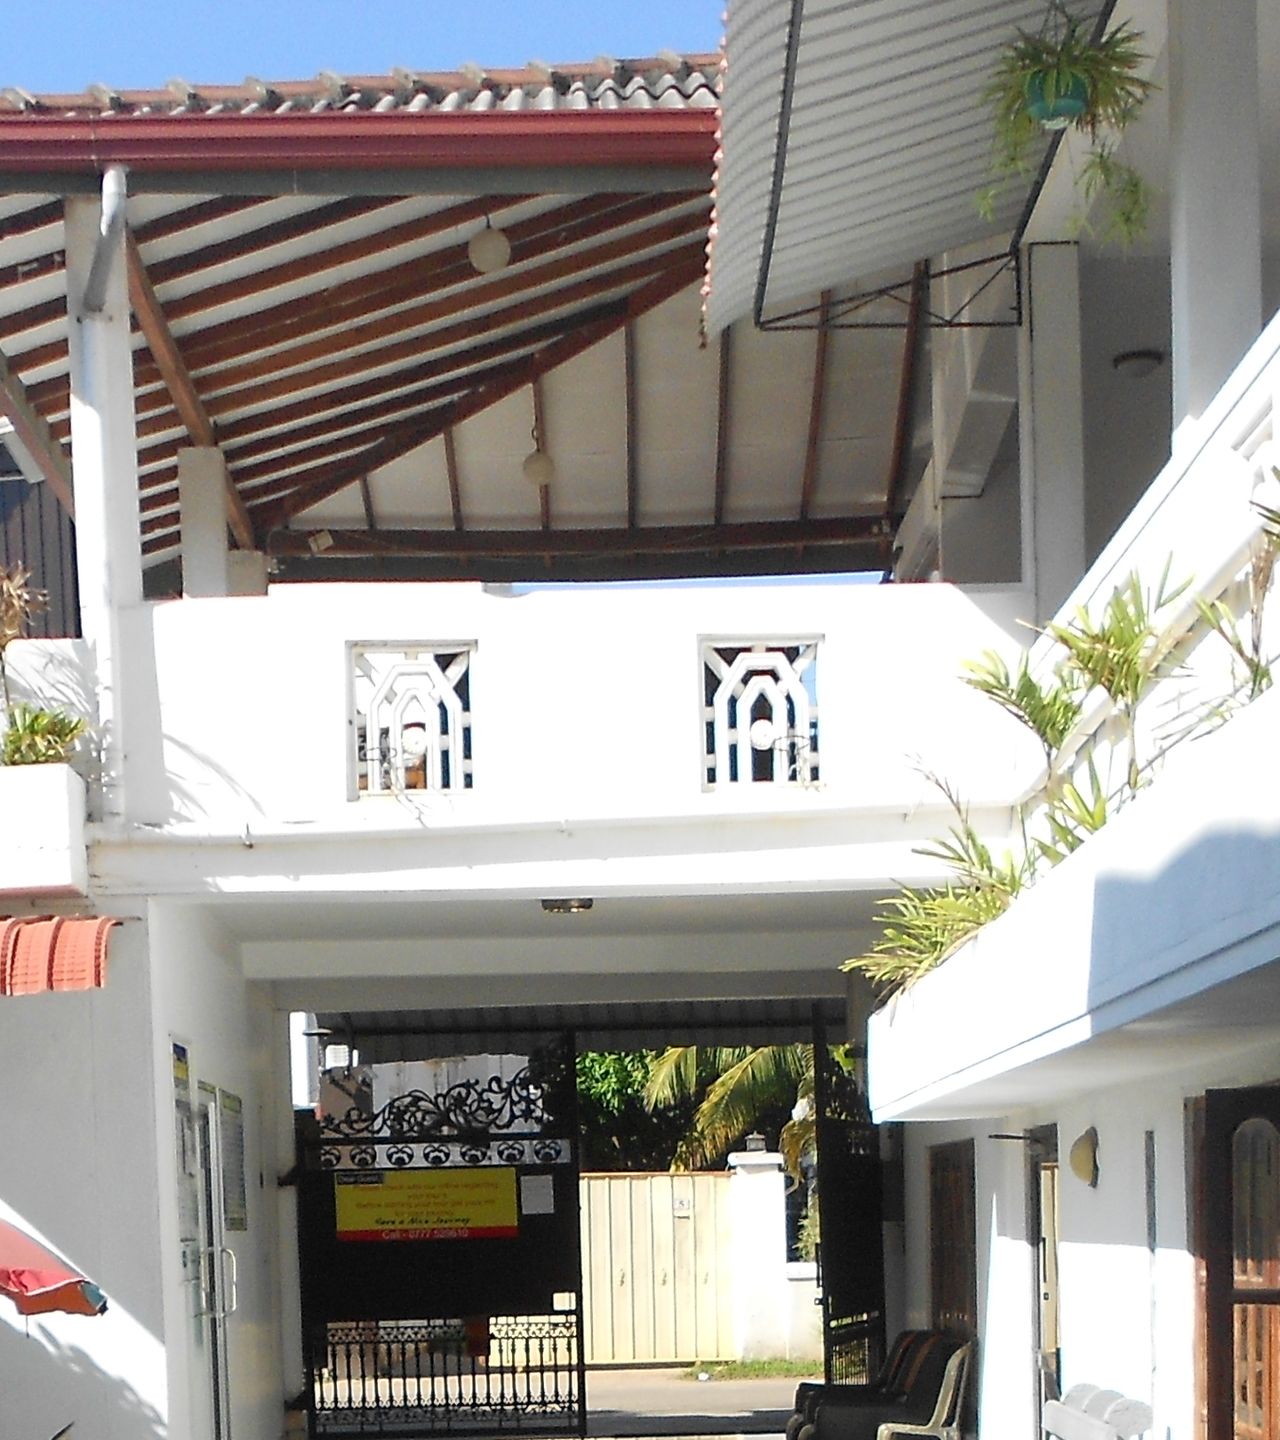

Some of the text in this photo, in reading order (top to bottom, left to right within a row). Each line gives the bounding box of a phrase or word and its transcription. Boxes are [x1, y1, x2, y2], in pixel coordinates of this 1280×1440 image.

[375, 1217, 396, 1225] Have
[408, 1217, 429, 1225] Nice
[432, 1217, 471, 1226] Journey
[382, 1230, 401, 1240] Call
